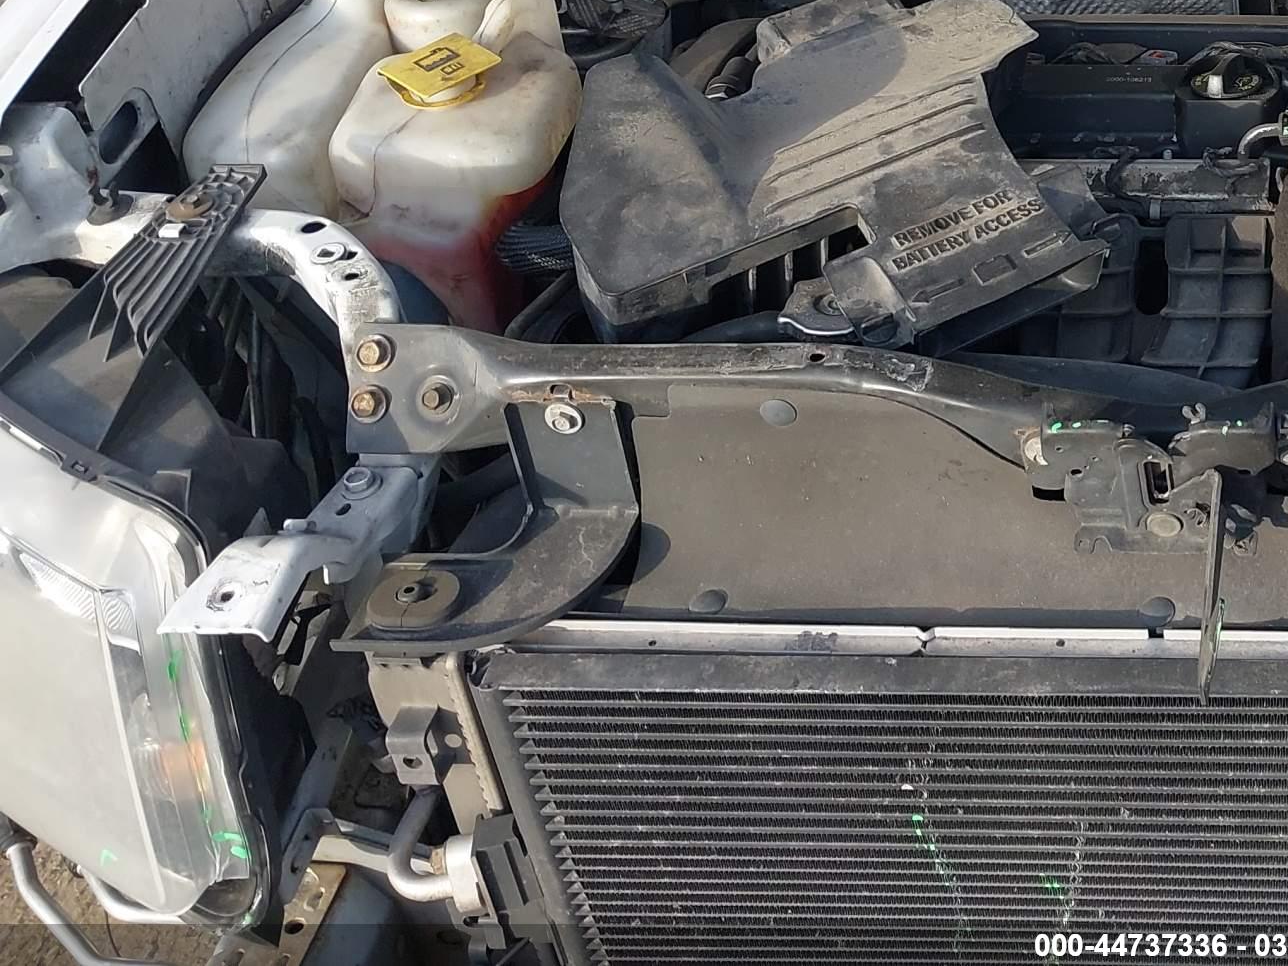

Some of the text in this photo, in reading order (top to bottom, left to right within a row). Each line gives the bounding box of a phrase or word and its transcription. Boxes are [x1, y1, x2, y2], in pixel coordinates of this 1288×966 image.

[891, 198, 1043, 273] BATTERY ACCESS
[892, 189, 1012, 248] REMOVE FOR
